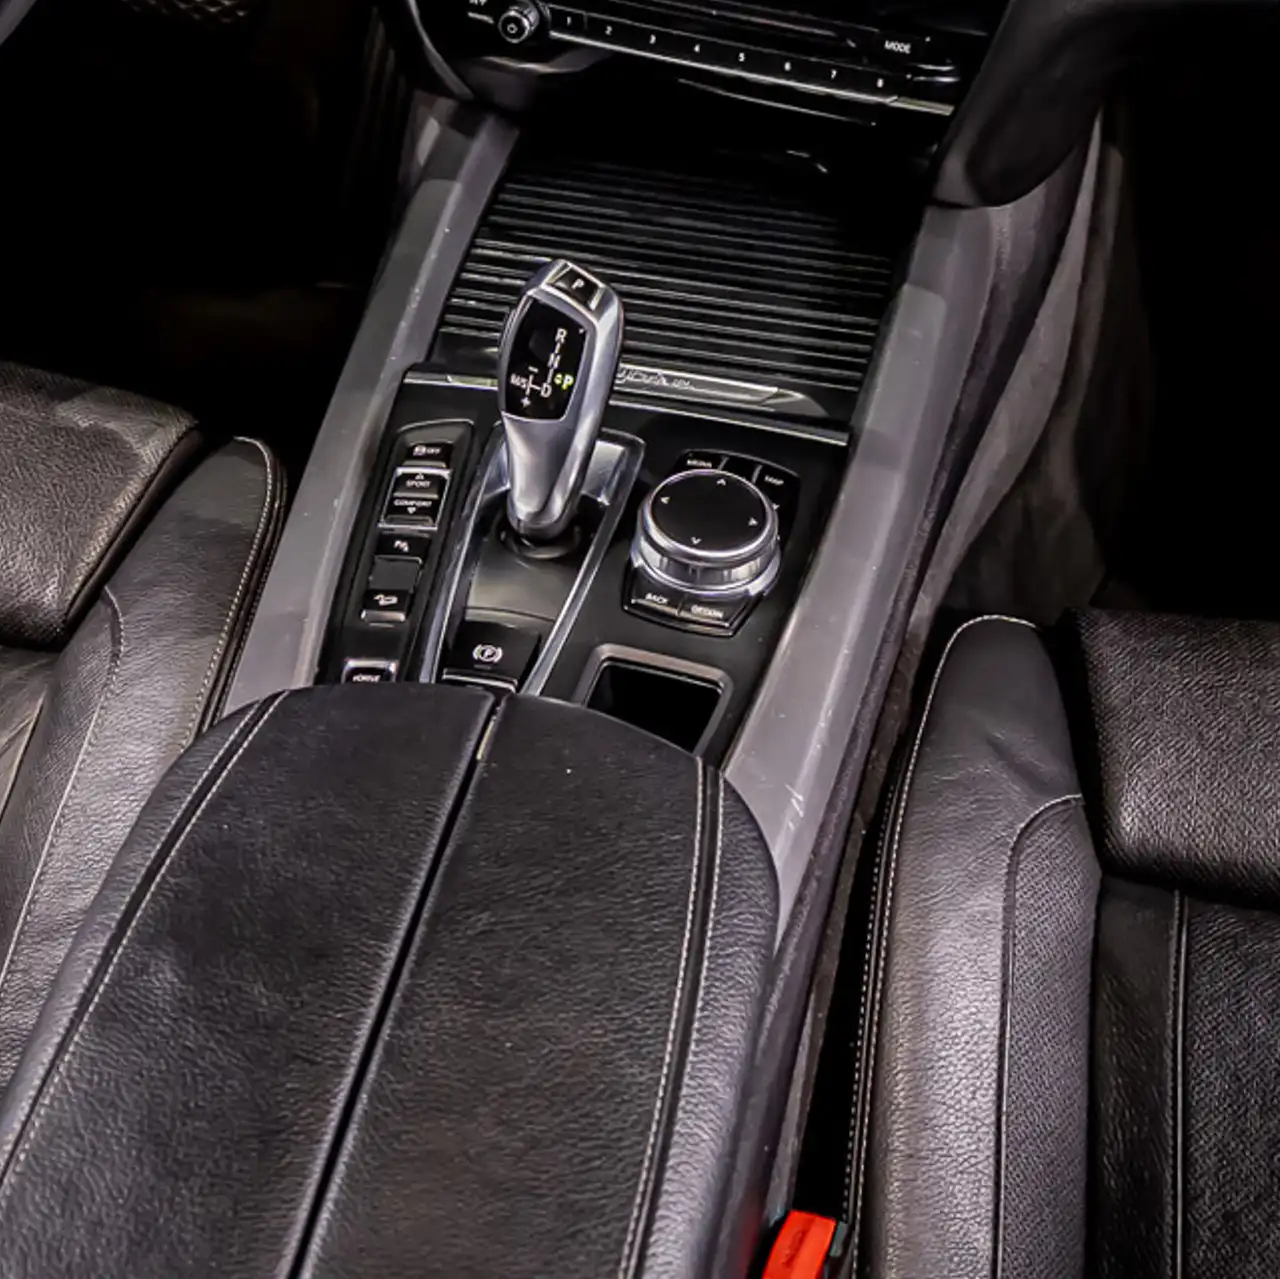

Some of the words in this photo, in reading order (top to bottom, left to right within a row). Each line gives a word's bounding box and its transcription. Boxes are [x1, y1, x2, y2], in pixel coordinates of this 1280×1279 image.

[883, 40, 912, 55] MODE
[571, 279, 585, 290] P
[555, 328, 567, 343] R
[547, 353, 560, 369] N
[540, 382, 552, 398] D
[405, 480, 431, 488] SPORT
[393, 499, 432, 507] COMFORT
[645, 592, 669, 604] BACK
